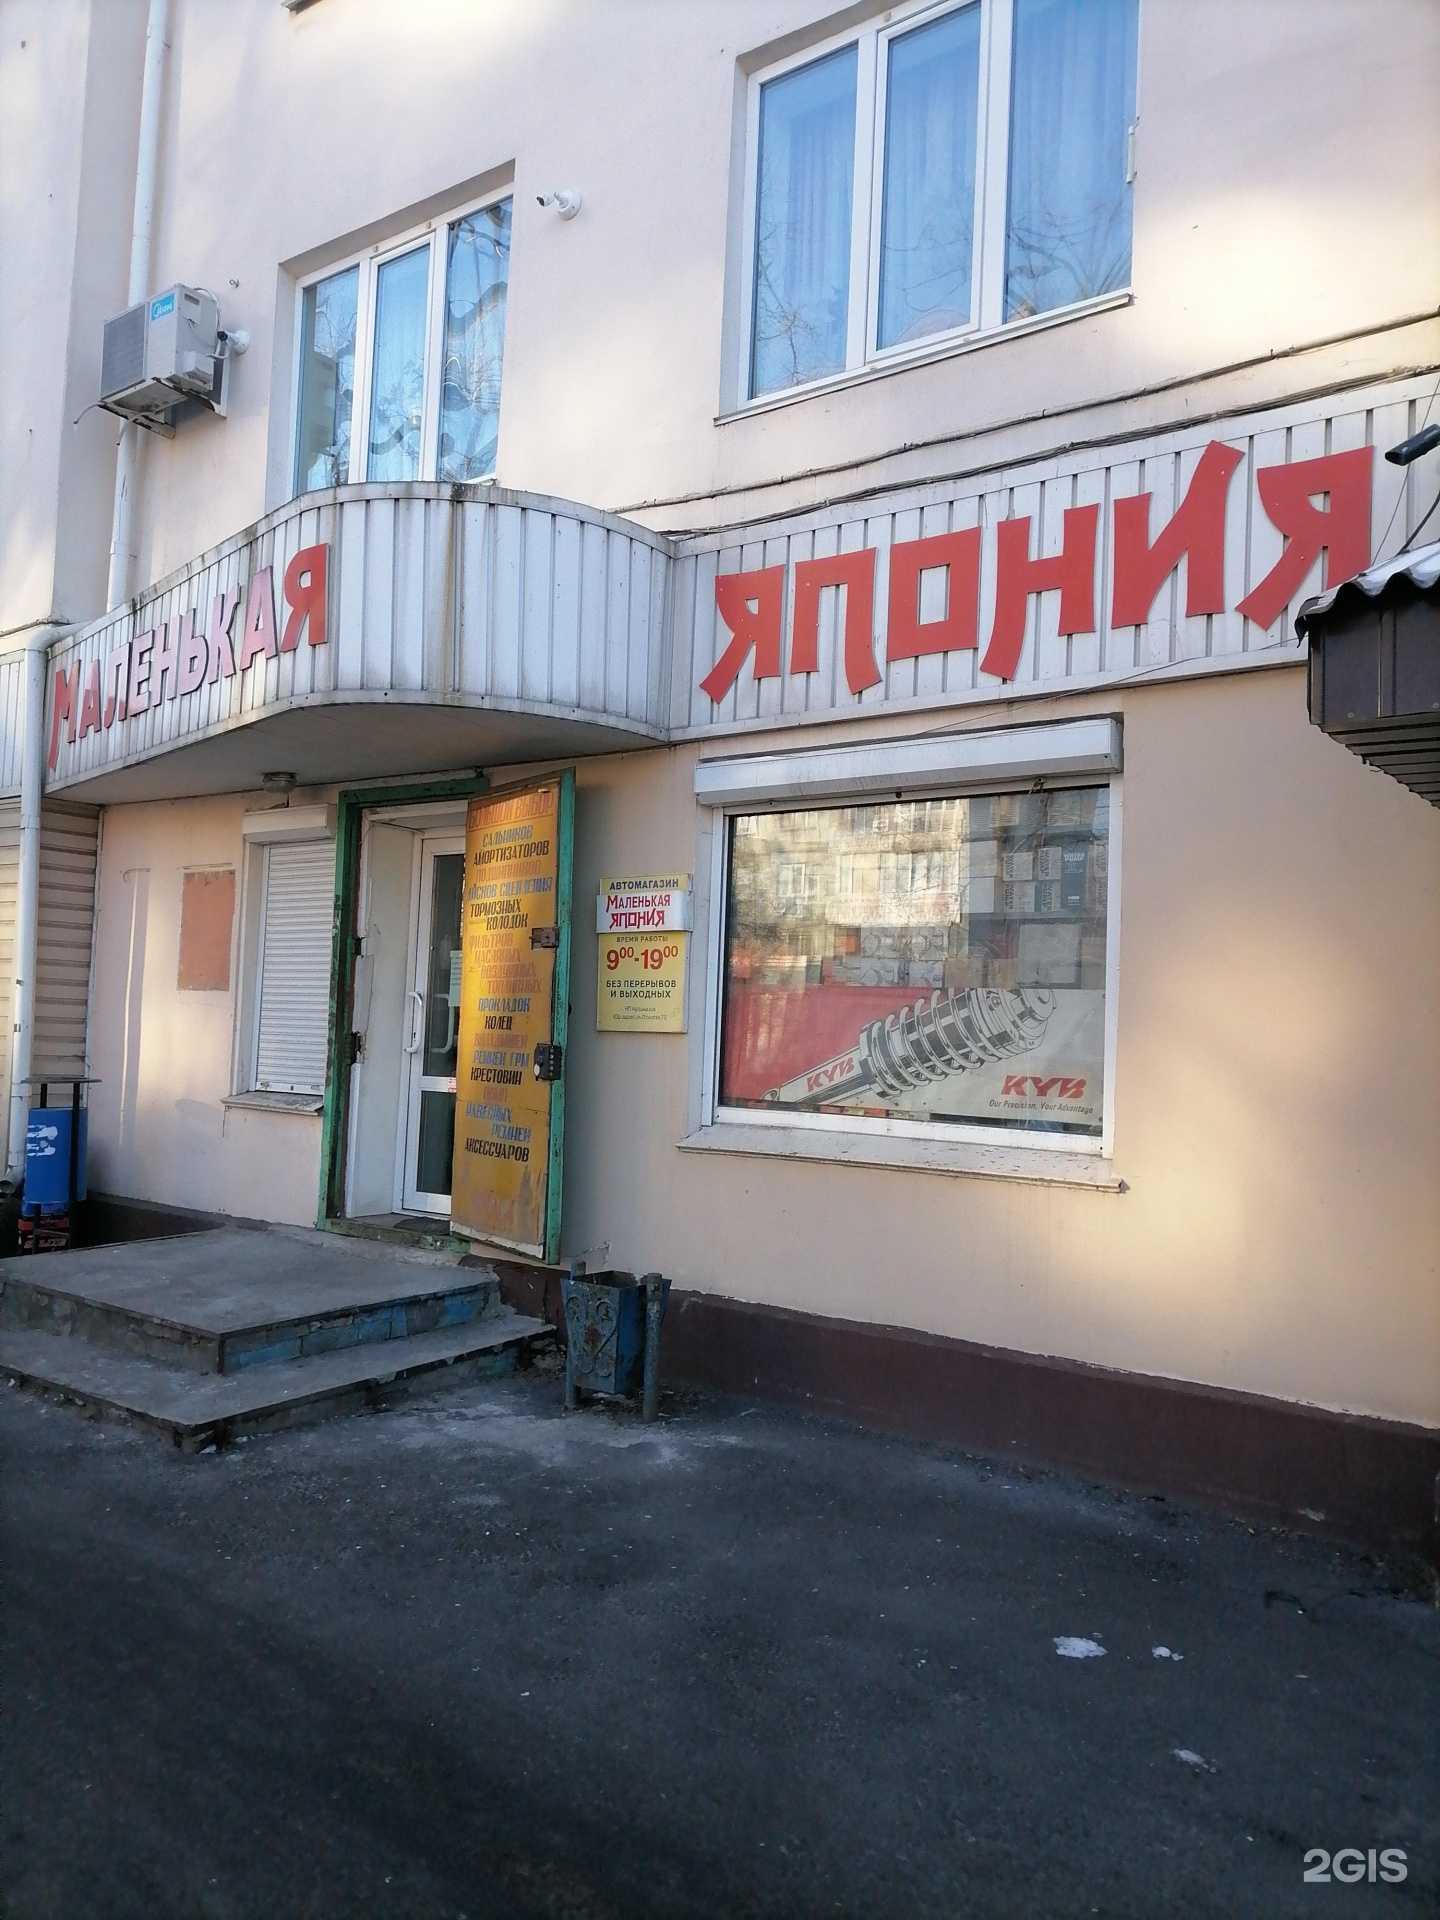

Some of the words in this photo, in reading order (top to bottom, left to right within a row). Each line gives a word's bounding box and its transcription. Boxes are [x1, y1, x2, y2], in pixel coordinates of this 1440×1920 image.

[699, 440, 1373, 704] ЯПОНИЯ
[48, 543, 329, 769] МАЛЕНЬКАЯ
[473, 840, 550, 866] АМОРТИЗАТОРОВ
[609, 879, 679, 891] АВТОМАГАЗИН
[470, 898, 522, 919] ТОРМОЗНЫХ
[486, 914, 529, 931] КОЛОДОК
[609, 908, 665, 930] ЯПОНИЯ
[606, 980, 622, 988] БЕЗ
[624, 980, 677, 988] ПЕРЕРЫВОВ
[610, 990, 617, 998] И
[620, 990, 671, 999] ВЫХОДНЫХ
[478, 997, 531, 1013] ПРОКЛАДОК
[484, 1015, 513, 1031] КОЛЕЦ
[470, 1067, 523, 1085] КРЕСТОВИН
[805, 1056, 855, 1093] KYB
[1001, 1074, 1087, 1099] KYB
[988, 1099, 1003, 1108] Our
[1040, 1101, 1057, 1111] Your
[464, 1137, 530, 1163] АКСЕССУАРОВ
